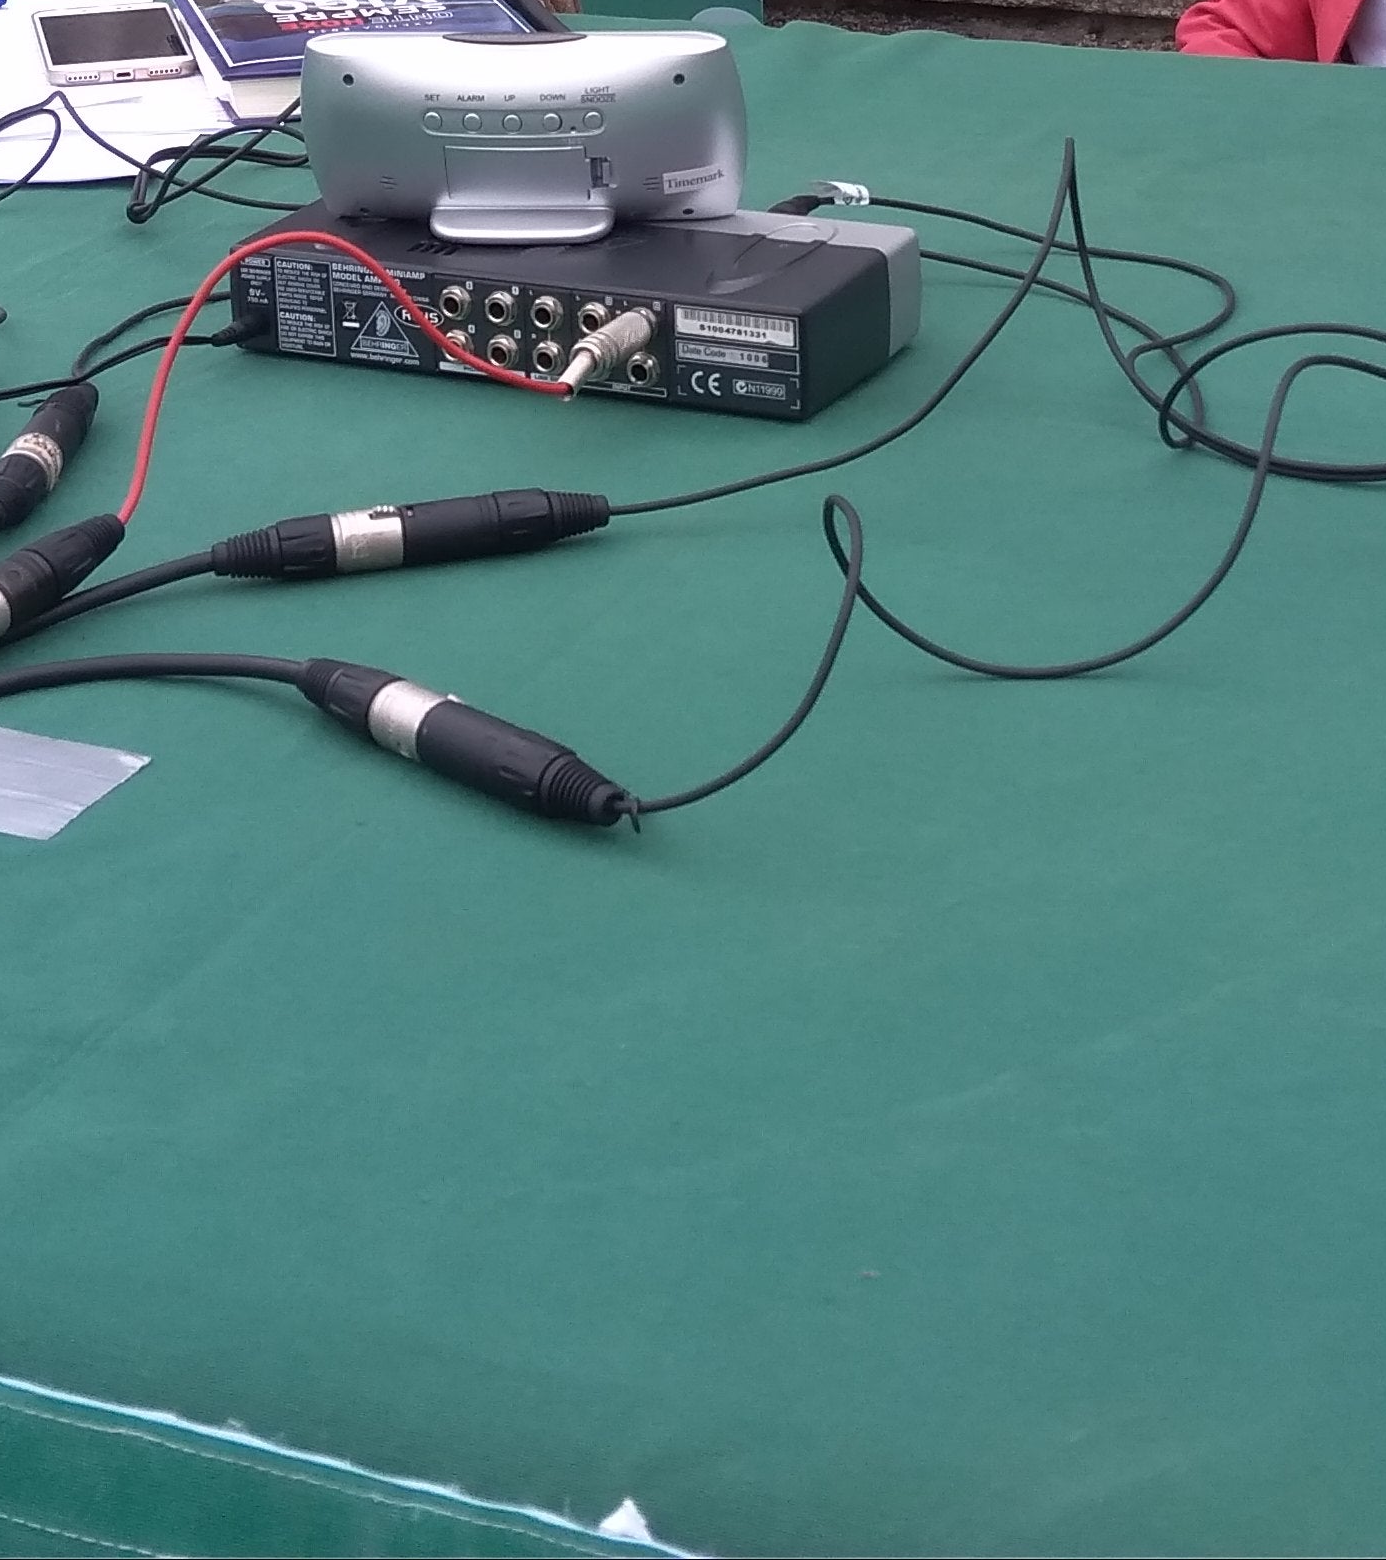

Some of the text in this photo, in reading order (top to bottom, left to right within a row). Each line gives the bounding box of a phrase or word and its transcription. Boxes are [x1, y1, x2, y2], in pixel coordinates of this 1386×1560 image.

[273, 2, 447, 23] SEMPRE
[424, 94, 441, 102] SET
[540, 94, 566, 102] DOWN
[666, 169, 725, 189] Timemark
[333, 272, 362, 281] MODEL
[682, 345, 701, 355] Date
[705, 347, 726, 358] Code
